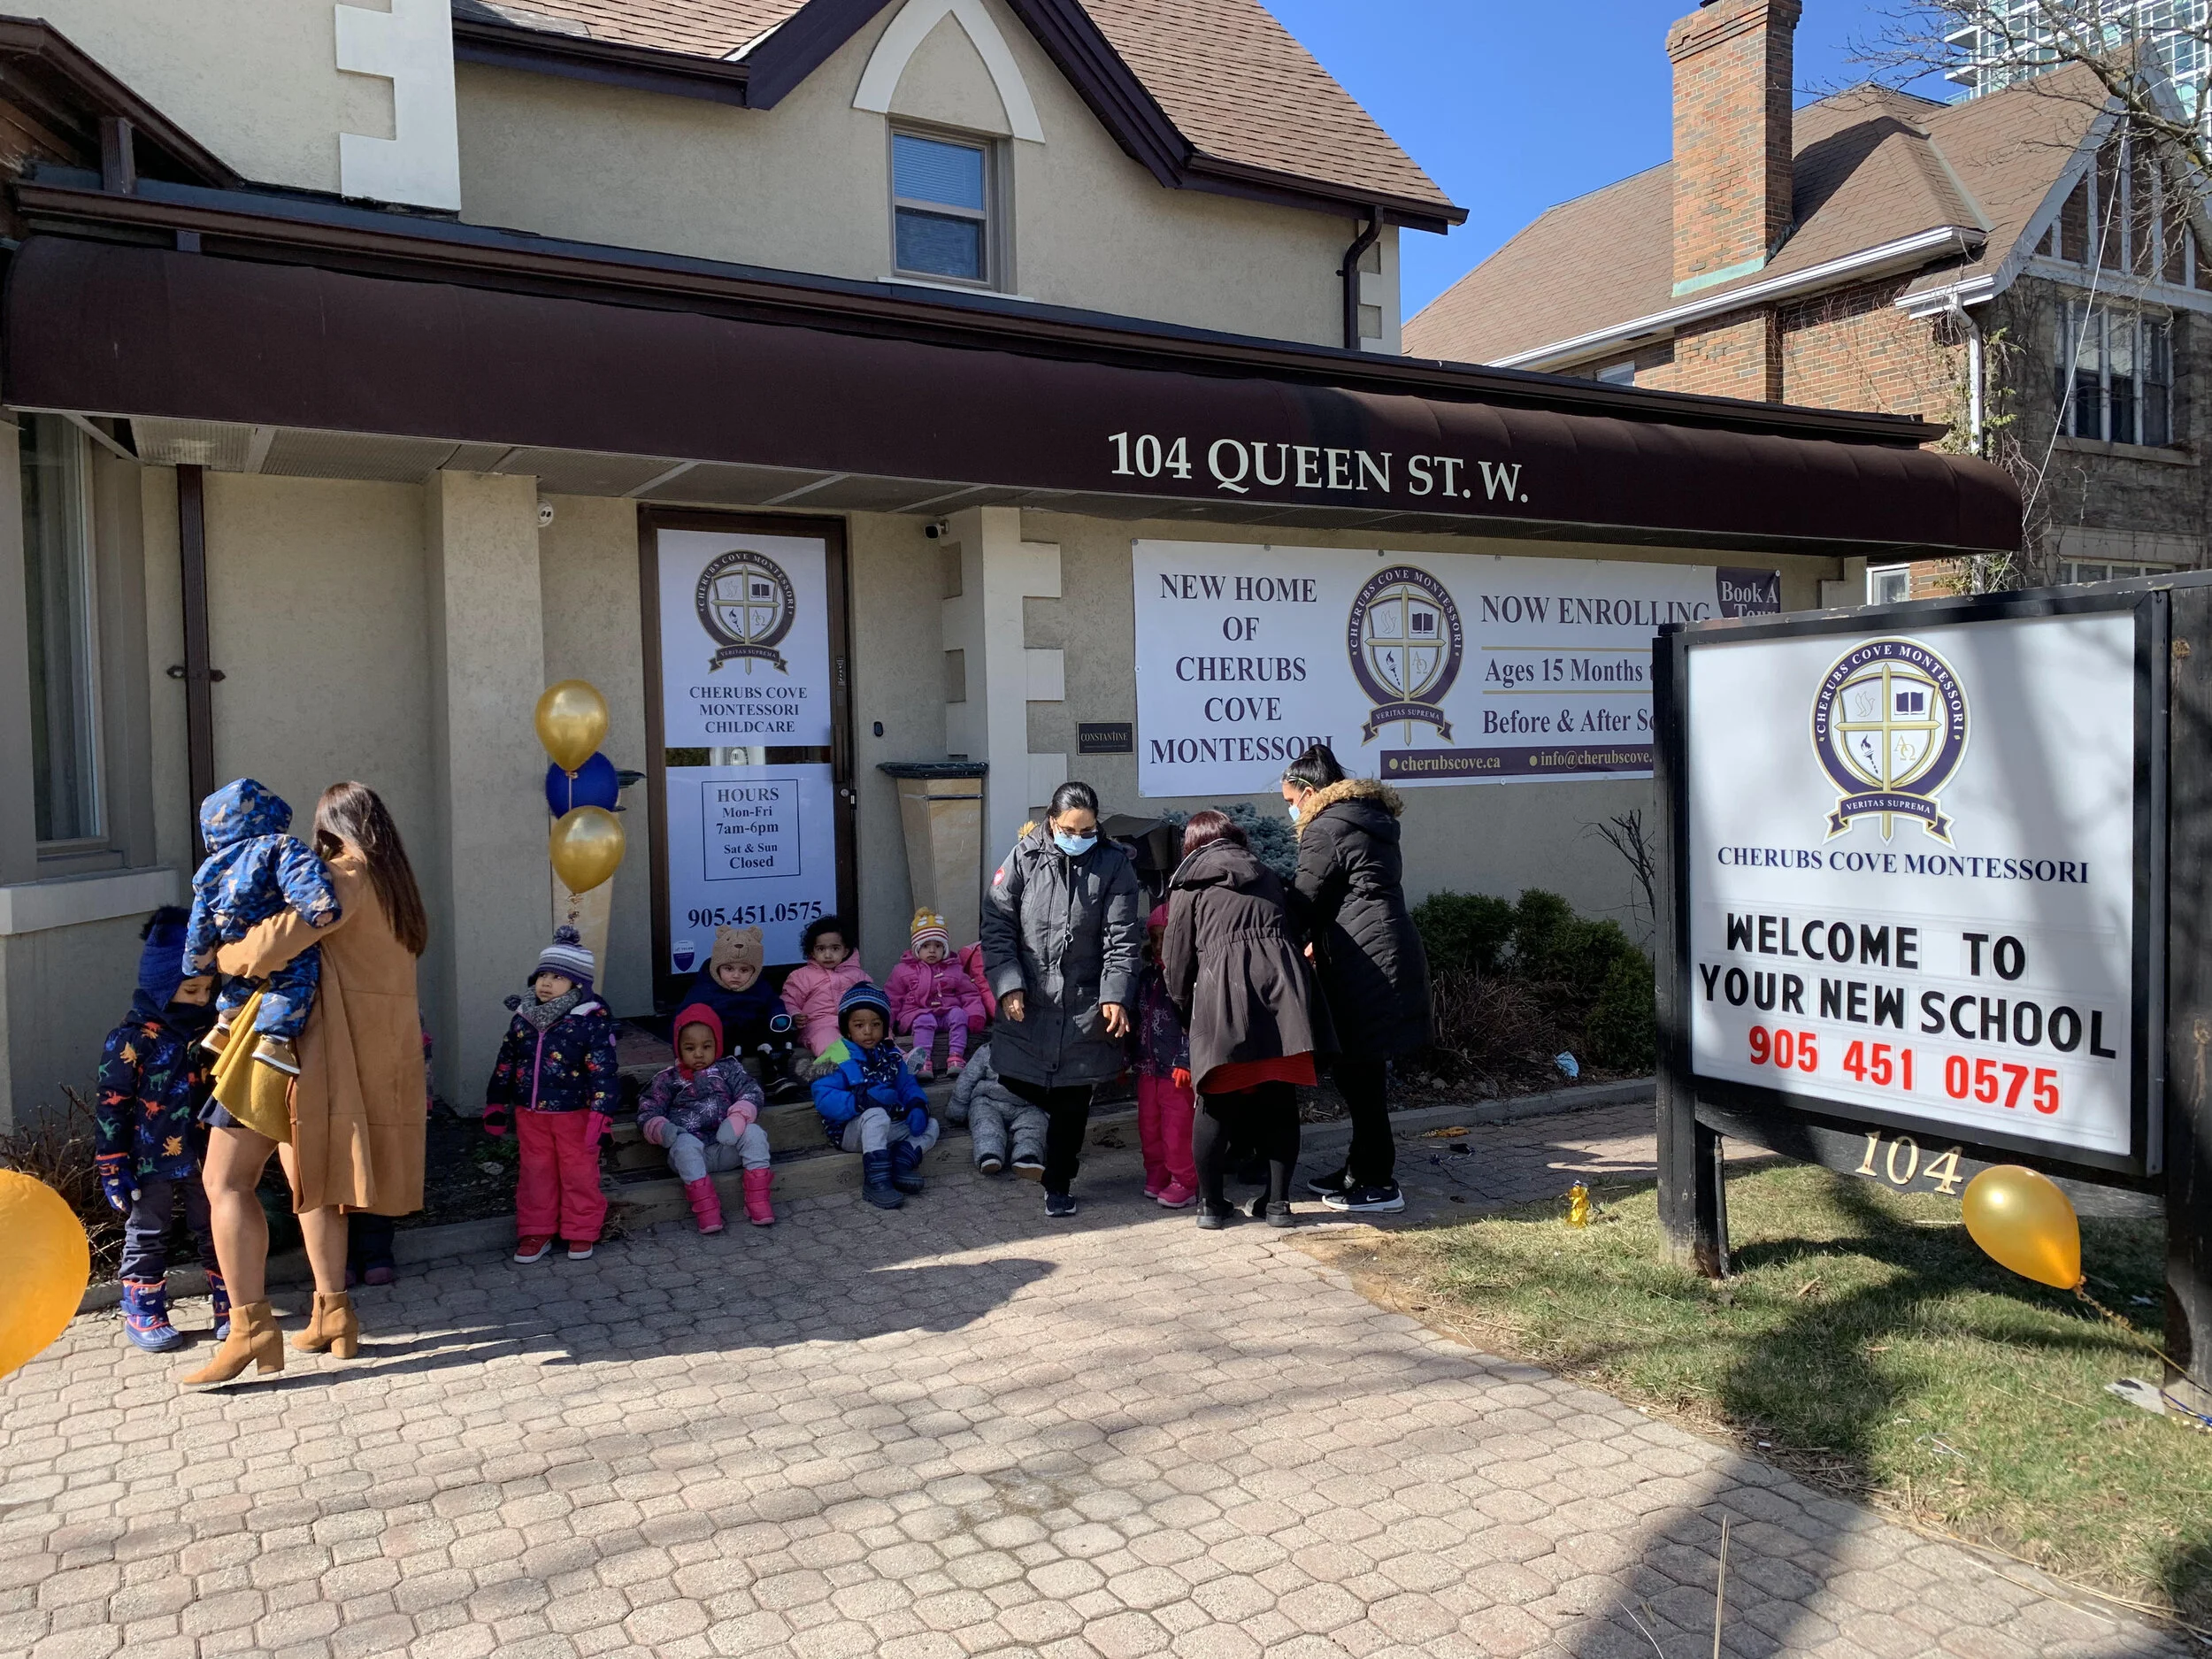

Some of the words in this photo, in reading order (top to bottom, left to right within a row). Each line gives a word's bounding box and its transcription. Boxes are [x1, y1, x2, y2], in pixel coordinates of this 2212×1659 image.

[1108, 431, 1192, 480] 104
[1207, 438, 1393, 494] QUEEN
[1408, 455, 1471, 499] ST.
[1478, 460, 1529, 503] W.
[698, 563, 720, 607] CHERUBS
[721, 552, 749, 564] COVE
[753, 555, 795, 610] MONTESSORI
[1160, 574, 1226, 600] NEW
[1235, 577, 1317, 603] HOME
[1721, 580, 1763, 603] Book
[1766, 584, 1778, 603] A
[1350, 584, 1375, 648] CHERUBS
[1379, 570, 1409, 585] COVE
[1415, 571, 1462, 649] MONTESSORI
[1481, 595, 1550, 623] NOW
[1558, 597, 1710, 625] ENROLLING
[1223, 617, 1259, 641] OF
[1175, 657, 1306, 682] CHERUBS
[1485, 658, 1534, 687] Ages
[1542, 658, 1563, 680] 15
[1570, 657, 1643, 681] Months
[689, 686, 762, 699] CHERUBS
[766, 687, 807, 699] COVE
[1817, 664, 1849, 733] CHERUBS
[1852, 644, 1893, 664] COVE
[1899, 645, 1964, 732] MONTESSORI
[699, 703, 799, 716] MONTESSORI
[1204, 697, 1282, 722] COVE
[1376, 709, 1406, 720] VERITAS
[1408, 710, 1440, 720] SUPREMA
[1483, 710, 1550, 733] Before
[1557, 710, 1574, 733] &
[1581, 708, 1632, 732] After
[705, 720, 795, 733] CHILDCARE
[1401, 756, 1501, 772] cherubscove.ca
[718, 787, 780, 803] HOURS
[1846, 800, 1886, 811] VERITAS
[1887, 800, 1932, 813] SUPREMA
[722, 806, 772, 818] Mon-Fri
[717, 822, 779, 836] 7am-6pm
[724, 844, 741, 854] Sat
[744, 843, 754, 853] &
[757, 842, 778, 852] Sun
[729, 856, 774, 870] Closed
[1717, 846, 1823, 870] CHERUBS
[1829, 851, 1897, 873] COVE
[1904, 854, 2089, 883] MONTESSORI
[688, 901, 822, 928] 905.451.0575
[1727, 913, 1918, 970] WELCOME
[1962, 933, 2026, 981] TO
[1699, 963, 1805, 1015] YOUR
[1819, 977, 1904, 1030] NEW
[1920, 990, 2116, 1059] SCHOOL
[1748, 1025, 1818, 1073] 905
[1843, 1040, 1913, 1091] 451
[1946, 1054, 2059, 1114] 0575
[1855, 1130, 1963, 1195] 104
